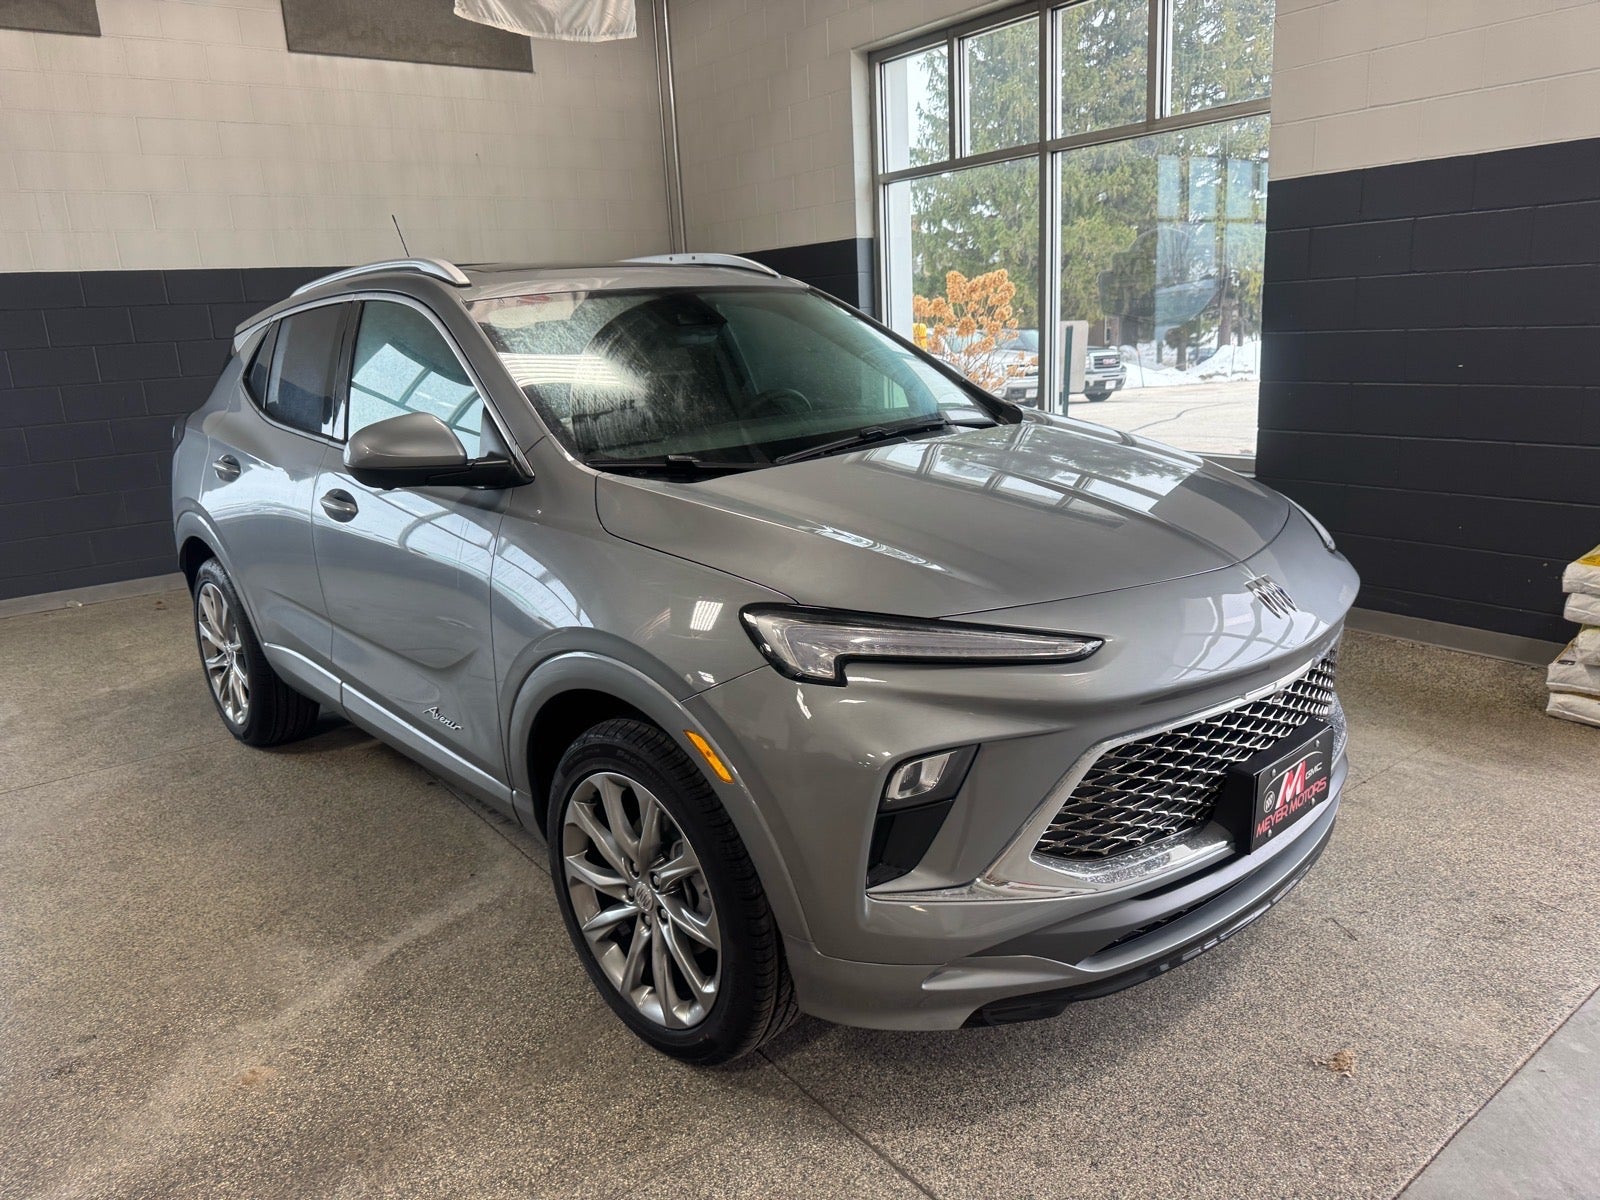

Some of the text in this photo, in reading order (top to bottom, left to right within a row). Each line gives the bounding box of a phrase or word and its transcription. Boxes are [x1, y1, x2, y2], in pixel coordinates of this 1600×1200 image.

[422, 706, 462, 730] Avenir
[1305, 762, 1323, 780] GMC
[1256, 776, 1327, 838] MEYER MOTORS
